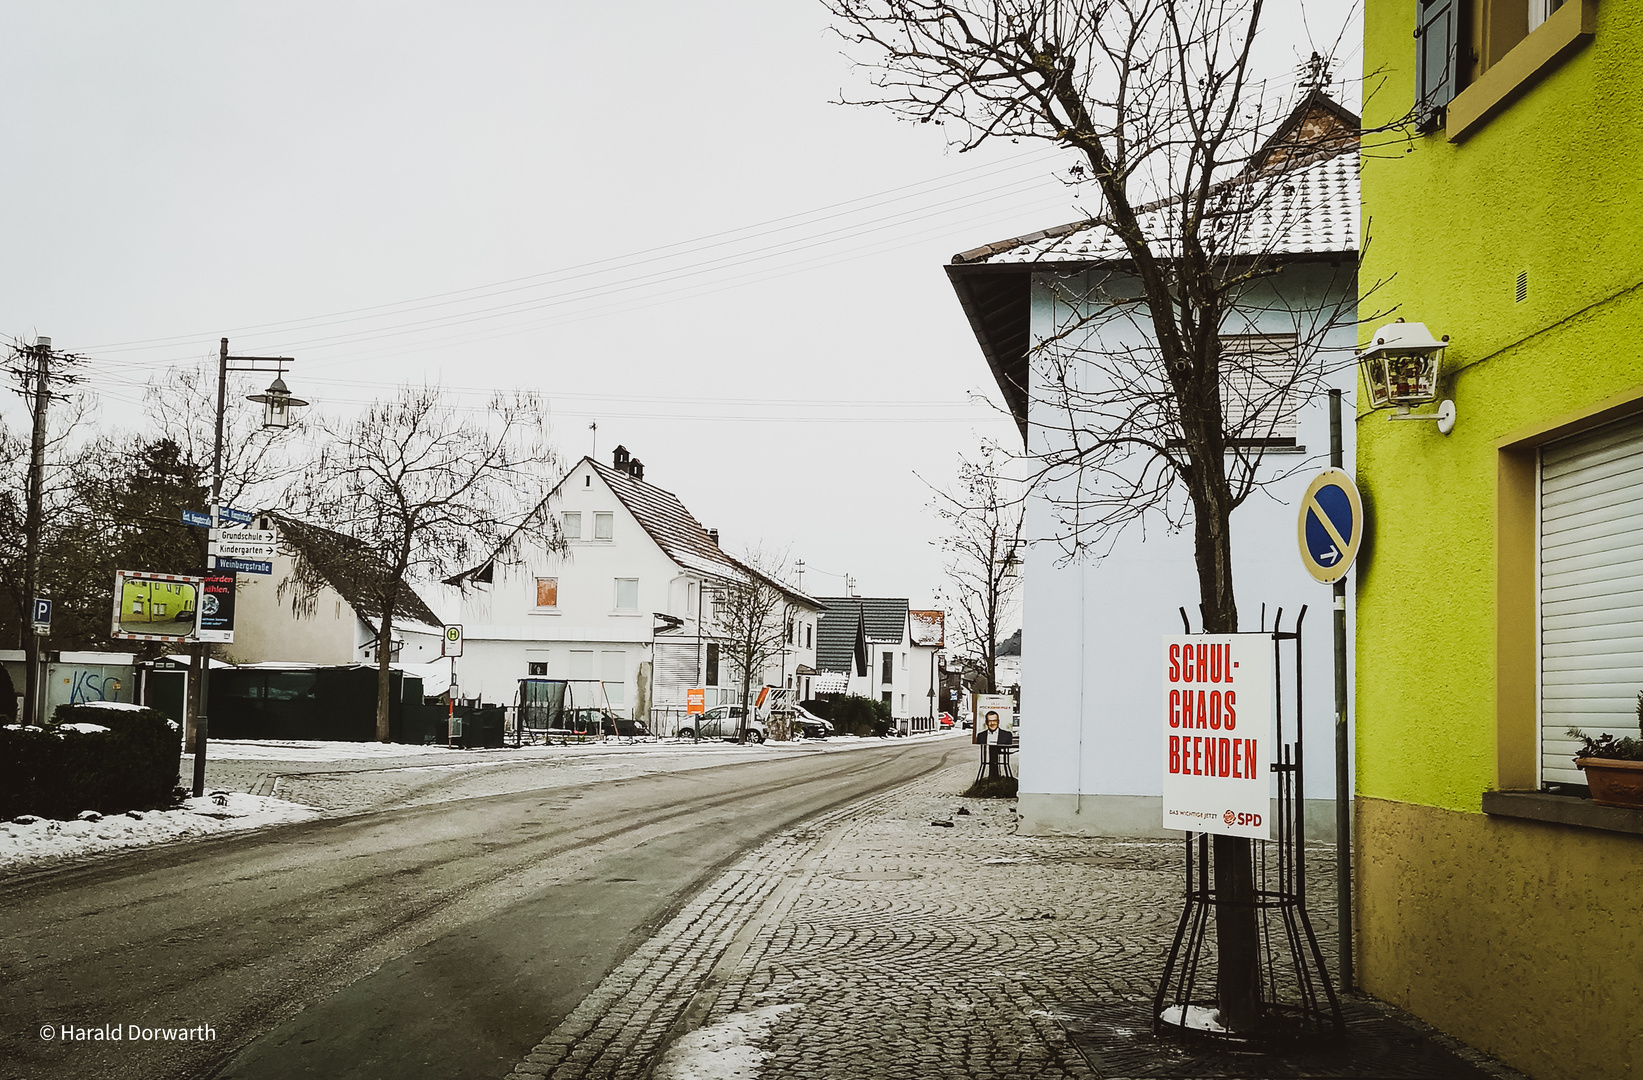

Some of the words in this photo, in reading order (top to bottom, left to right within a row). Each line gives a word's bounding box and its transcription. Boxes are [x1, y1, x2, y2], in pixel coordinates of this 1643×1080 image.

[221, 531, 263, 541] Grundschule
[219, 545, 263, 555] Kindergarten
[220, 559, 270, 572] Weinbergstraße
[37, 602, 48, 619] P
[1169, 643, 1240, 683] SCHUL-
[1169, 689, 1236, 731] CHAOS
[1169, 735, 1257, 780] BEENDEN
[1179, 810, 1203, 818] WICHTIGE
[1237, 812, 1262, 827] SPD
